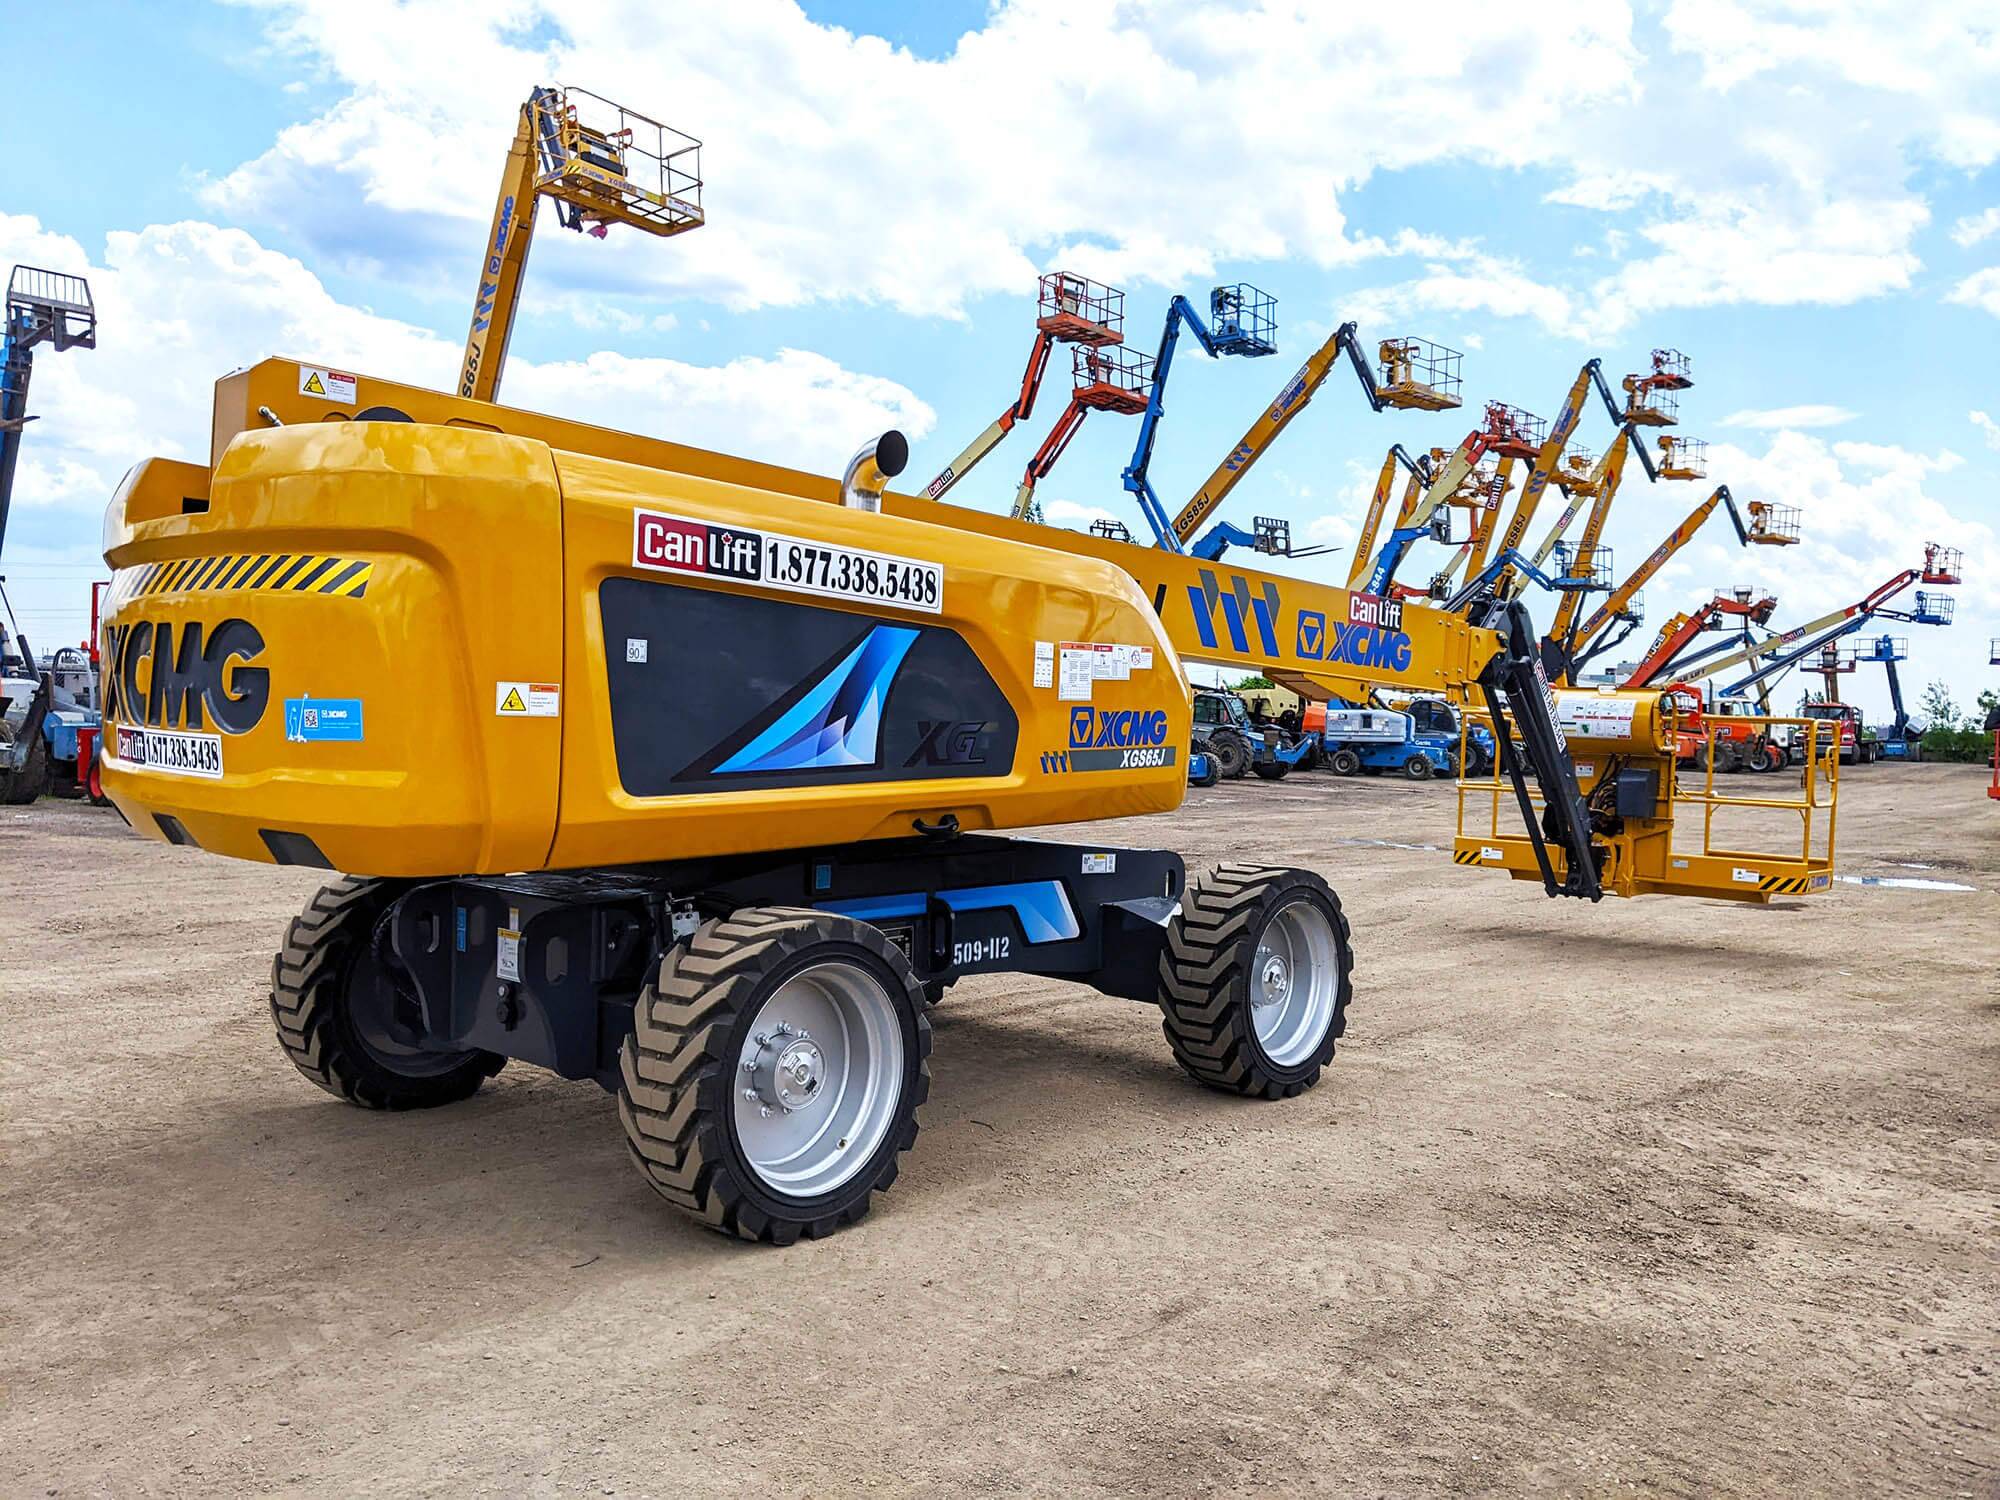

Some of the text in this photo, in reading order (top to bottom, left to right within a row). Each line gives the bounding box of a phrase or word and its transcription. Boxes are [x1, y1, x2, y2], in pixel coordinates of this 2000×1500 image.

[496, 196, 514, 250] XCMG
[929, 468, 954, 496] CanLift
[1487, 475, 1505, 510] CanLift
[1174, 492, 1210, 537] XGS85J
[644, 522, 937, 604] CanLift 1.877.338.5438
[1351, 596, 1400, 629] CanLift
[1327, 621, 1412, 672] XCMG
[104, 618, 271, 736] XCMG
[1094, 710, 1168, 748] XCMG
[119, 732, 219, 771] CanLift 1.877.338.5438
[1120, 749, 1166, 768] XGS65J
[953, 936, 1009, 966] 509-112
